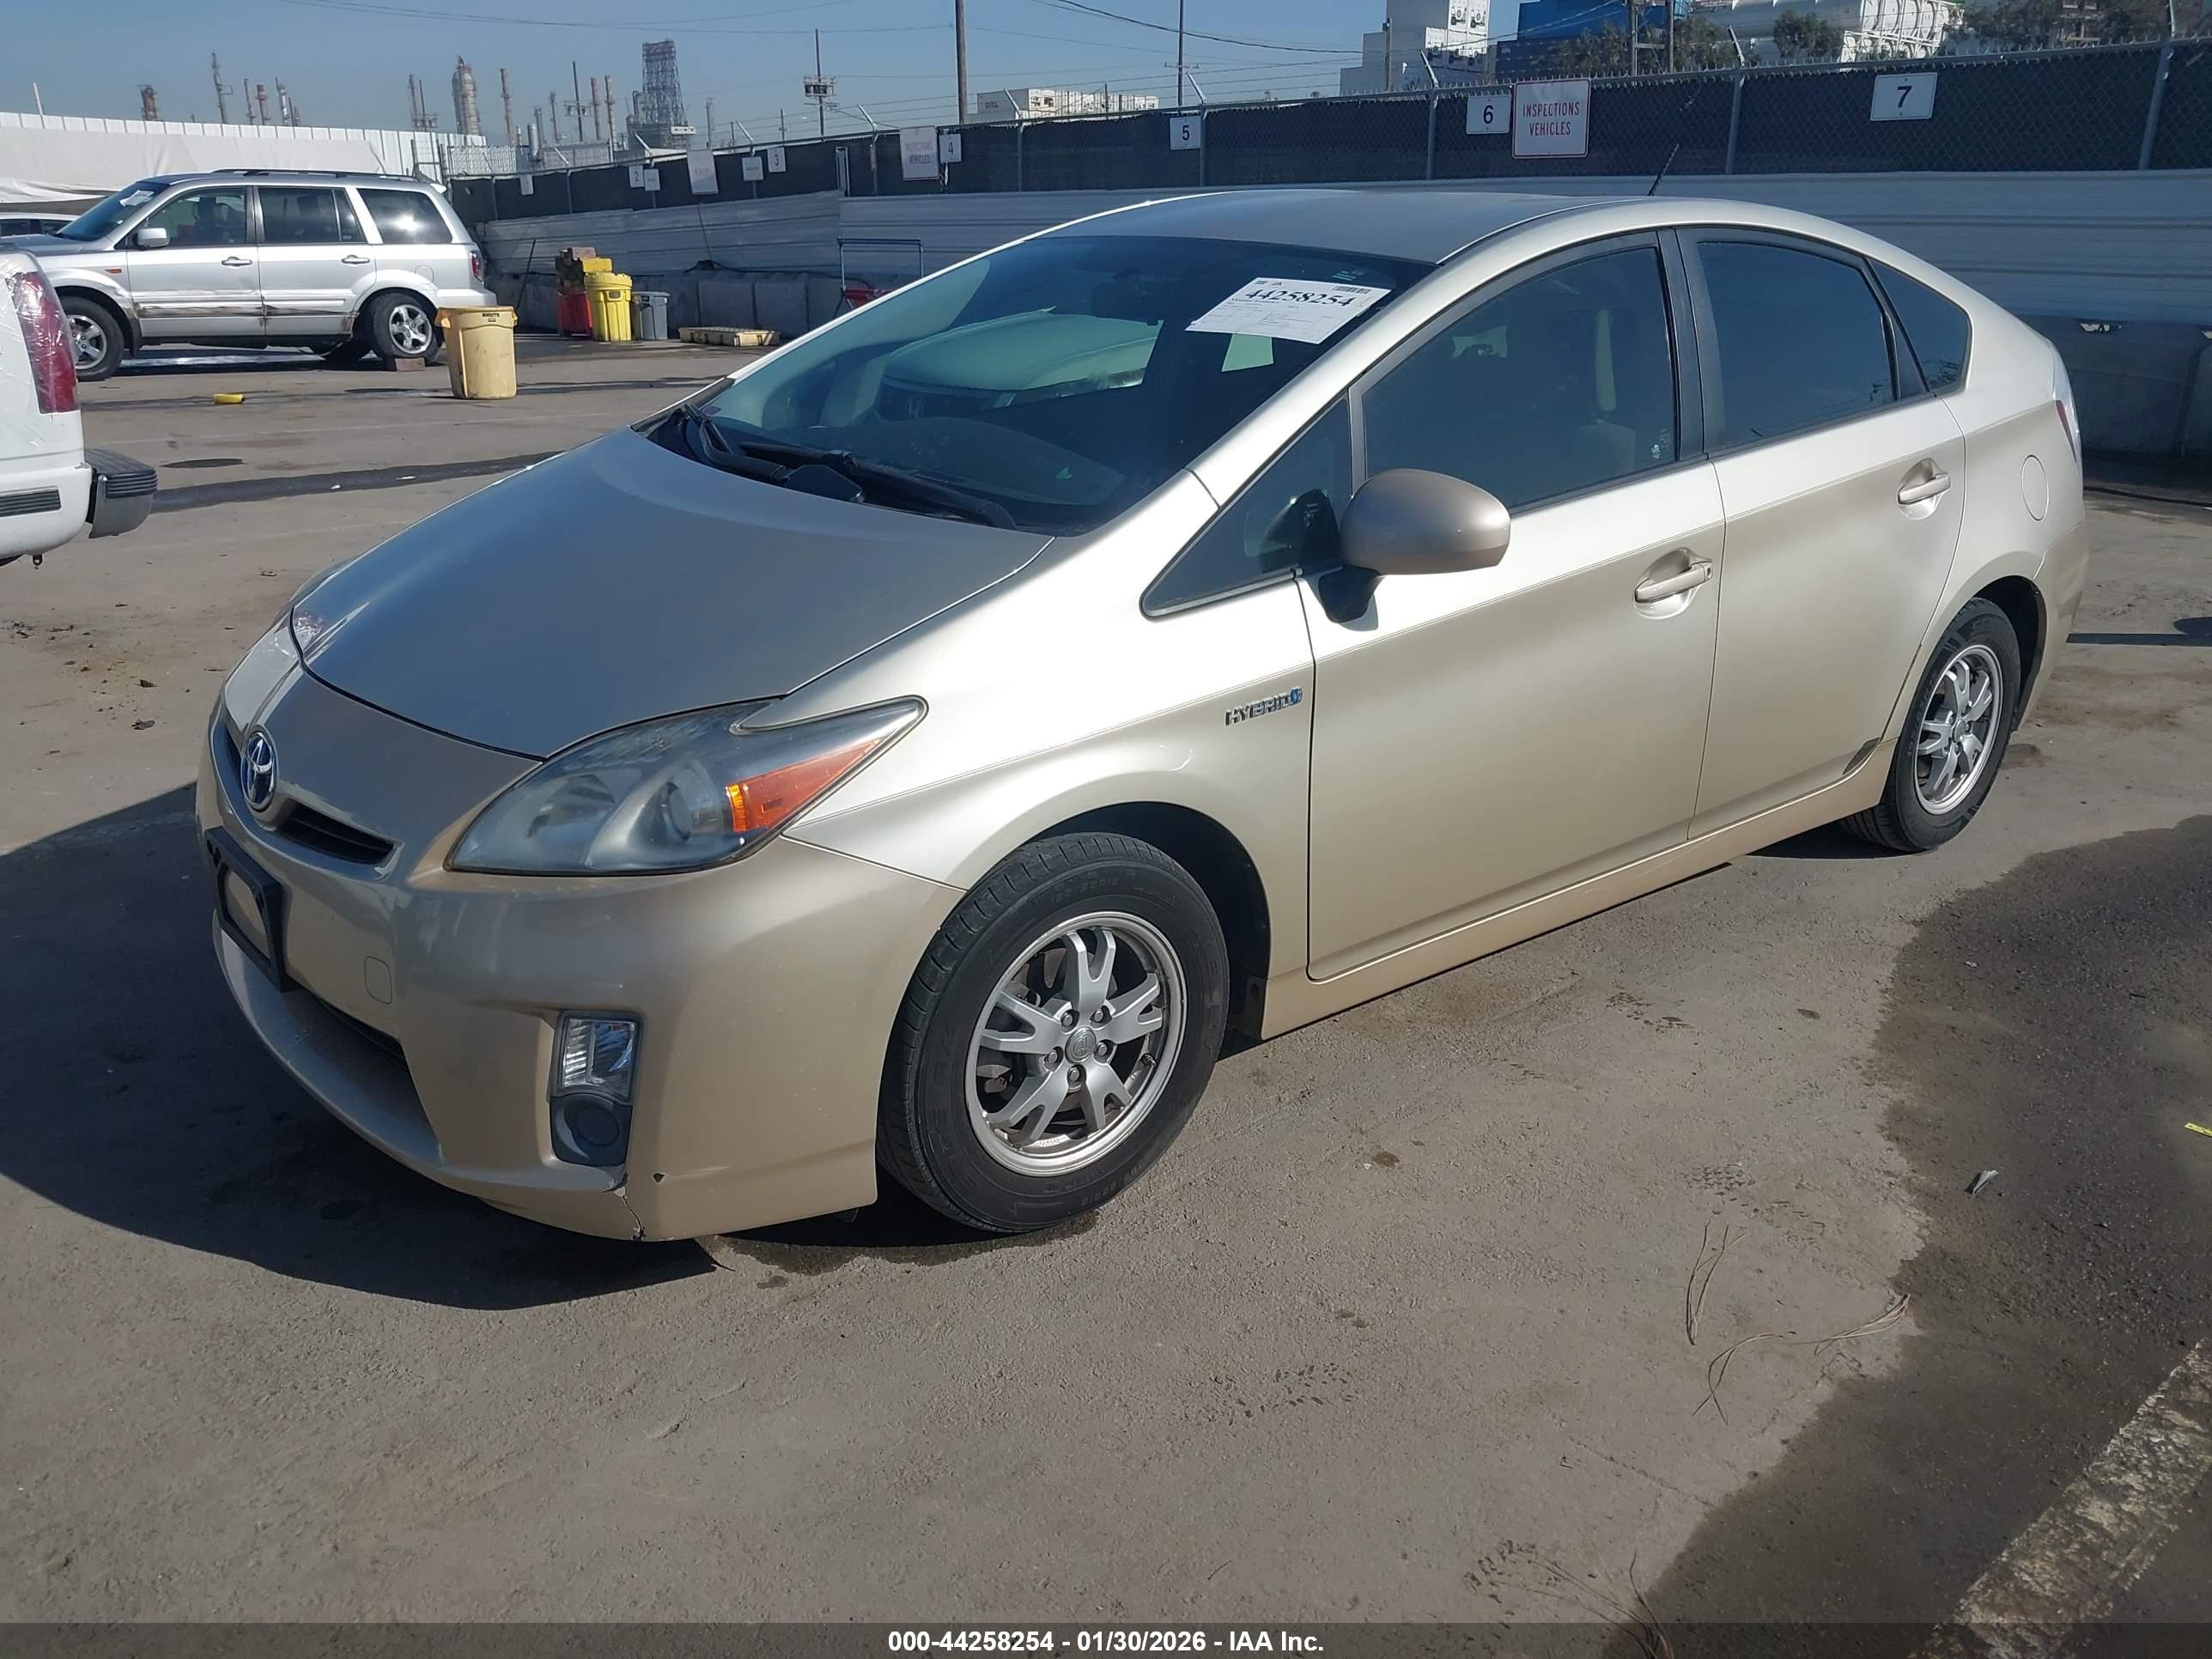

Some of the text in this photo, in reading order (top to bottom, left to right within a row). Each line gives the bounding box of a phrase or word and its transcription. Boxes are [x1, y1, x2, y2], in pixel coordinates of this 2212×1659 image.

[1897, 86, 1912, 108] 7
[1483, 105, 1494, 125] 6
[1522, 101, 1580, 118] INSPECTIONS
[1182, 125, 1190, 141] 5
[1529, 122, 1571, 137] VEHICLES
[948, 142, 954, 155] 4
[774, 154, 779, 166] 3
[634, 171, 639, 182] 2
[1245, 289, 1356, 307] 44258254
[1225, 690, 1292, 727] HYBRID
